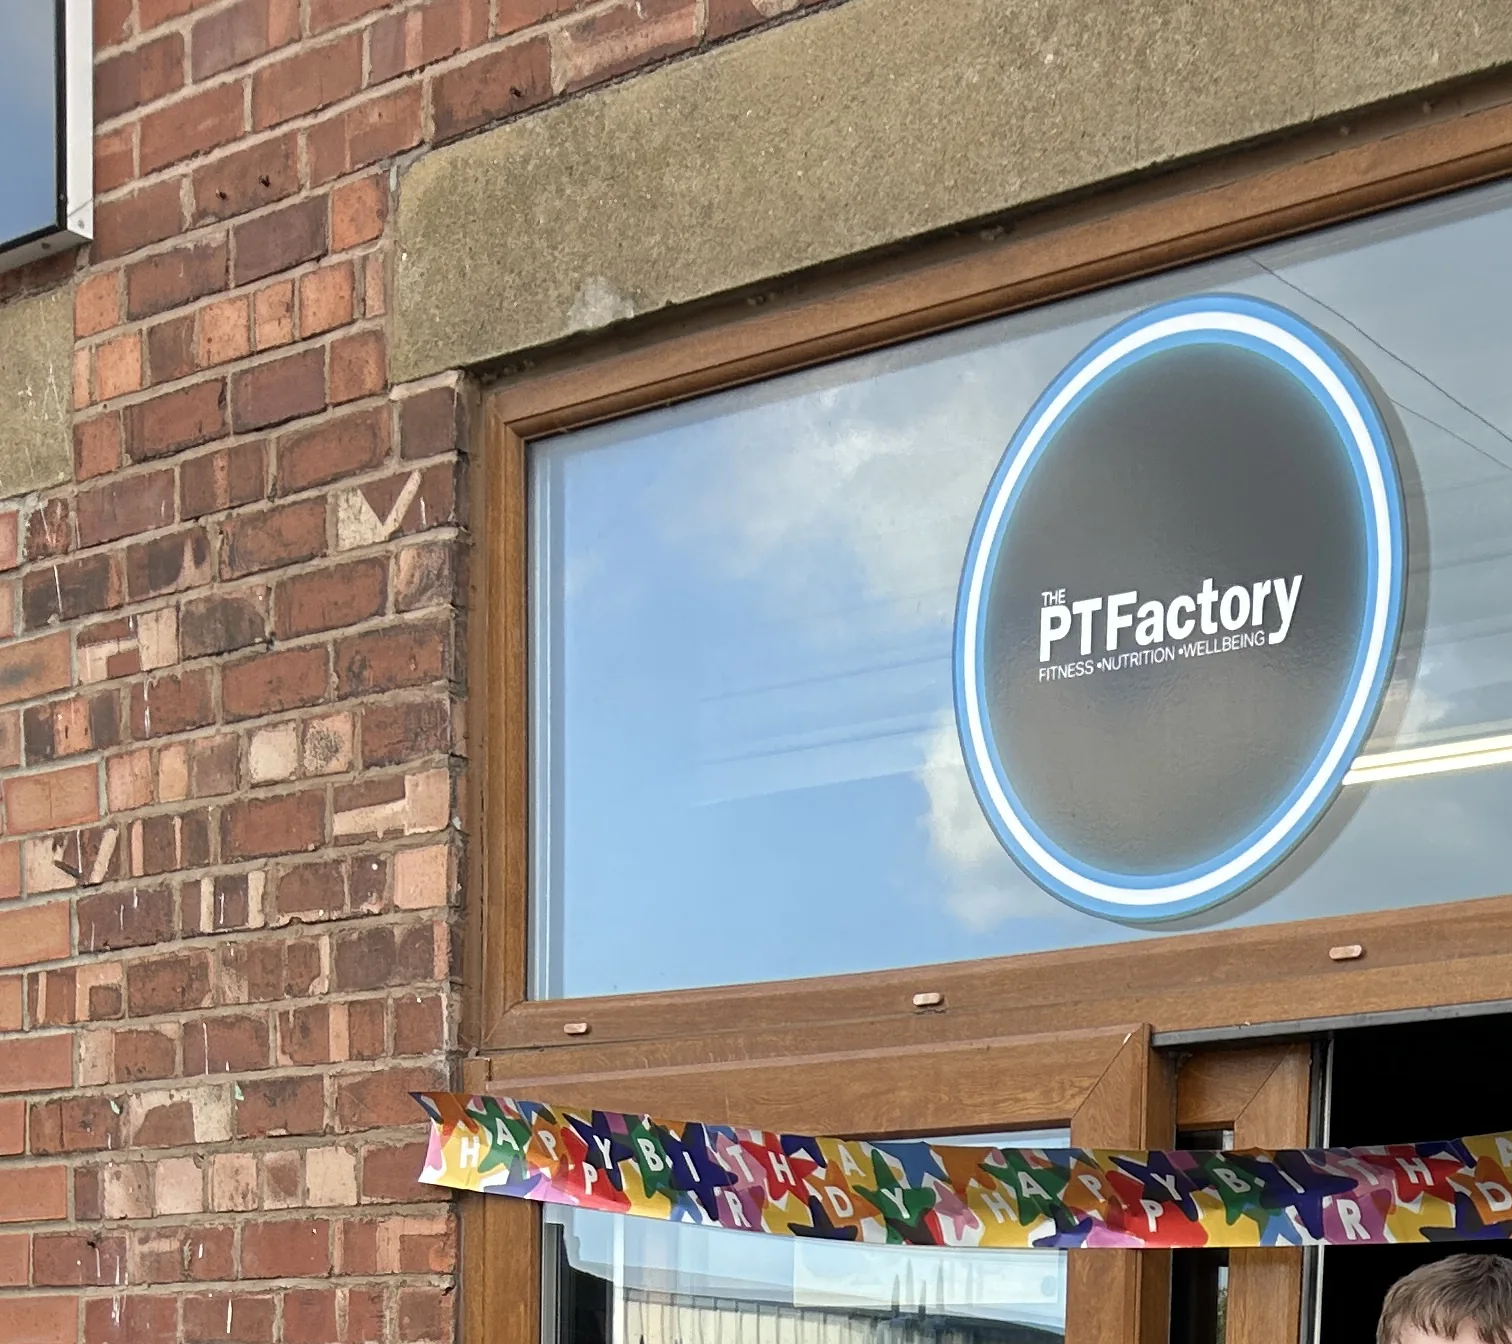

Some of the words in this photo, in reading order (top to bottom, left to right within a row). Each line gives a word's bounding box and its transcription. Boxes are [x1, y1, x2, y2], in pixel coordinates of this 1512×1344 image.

[1041, 588, 1066, 607] THE
[1039, 661, 1094, 683] FITNESS
[460, 1116, 614, 1195] HAPPY
[636, 1136, 910, 1229] BIRTHDAY
[980, 1170, 1184, 1232] HAPPY
